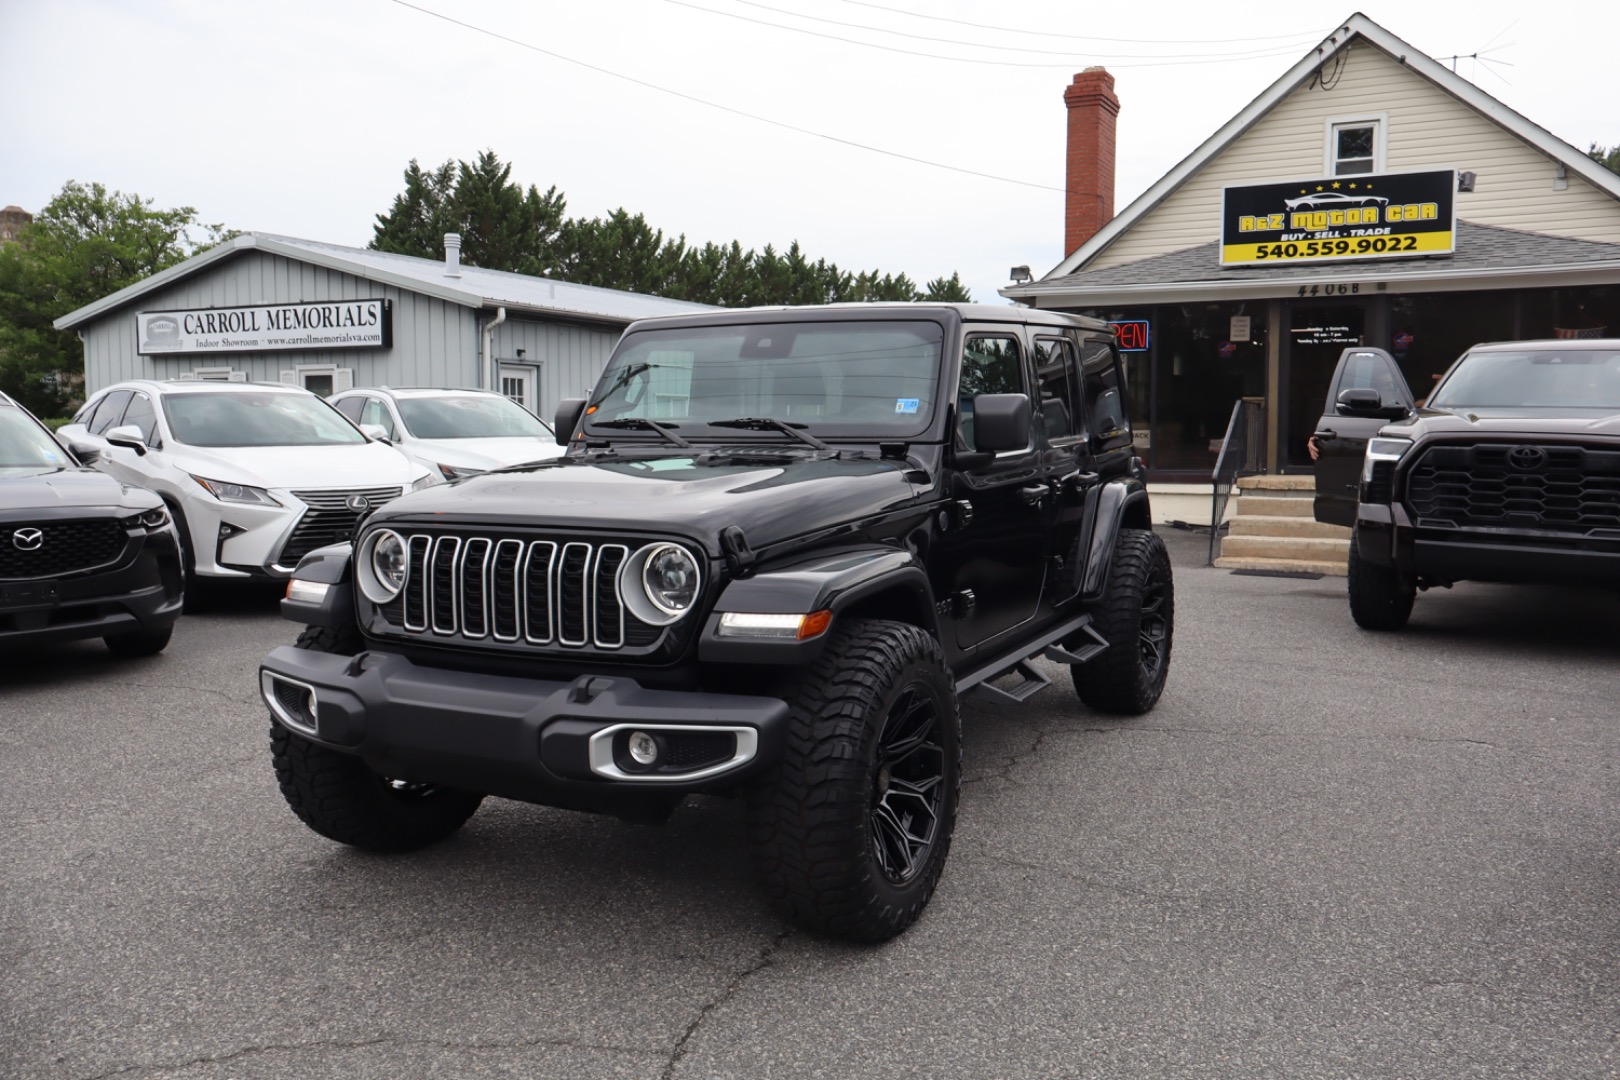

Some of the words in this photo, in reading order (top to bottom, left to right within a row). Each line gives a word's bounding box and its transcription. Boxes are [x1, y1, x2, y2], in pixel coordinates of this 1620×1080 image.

[1281, 233, 1306, 242] BUY
[1314, 231, 1341, 240] SELL
[1350, 228, 1391, 237] TRADE
[1256, 236, 1418, 259] 540.559.9022
[184, 311, 261, 335] CARROLL
[266, 304, 378, 331] MEMORIALS
[196, 338, 219, 348] Indoor
[222, 338, 259, 348] Showroom
[267, 332, 380, 345] www.carrollmemorialsva.com
[1109, 323, 1147, 348] PEN
